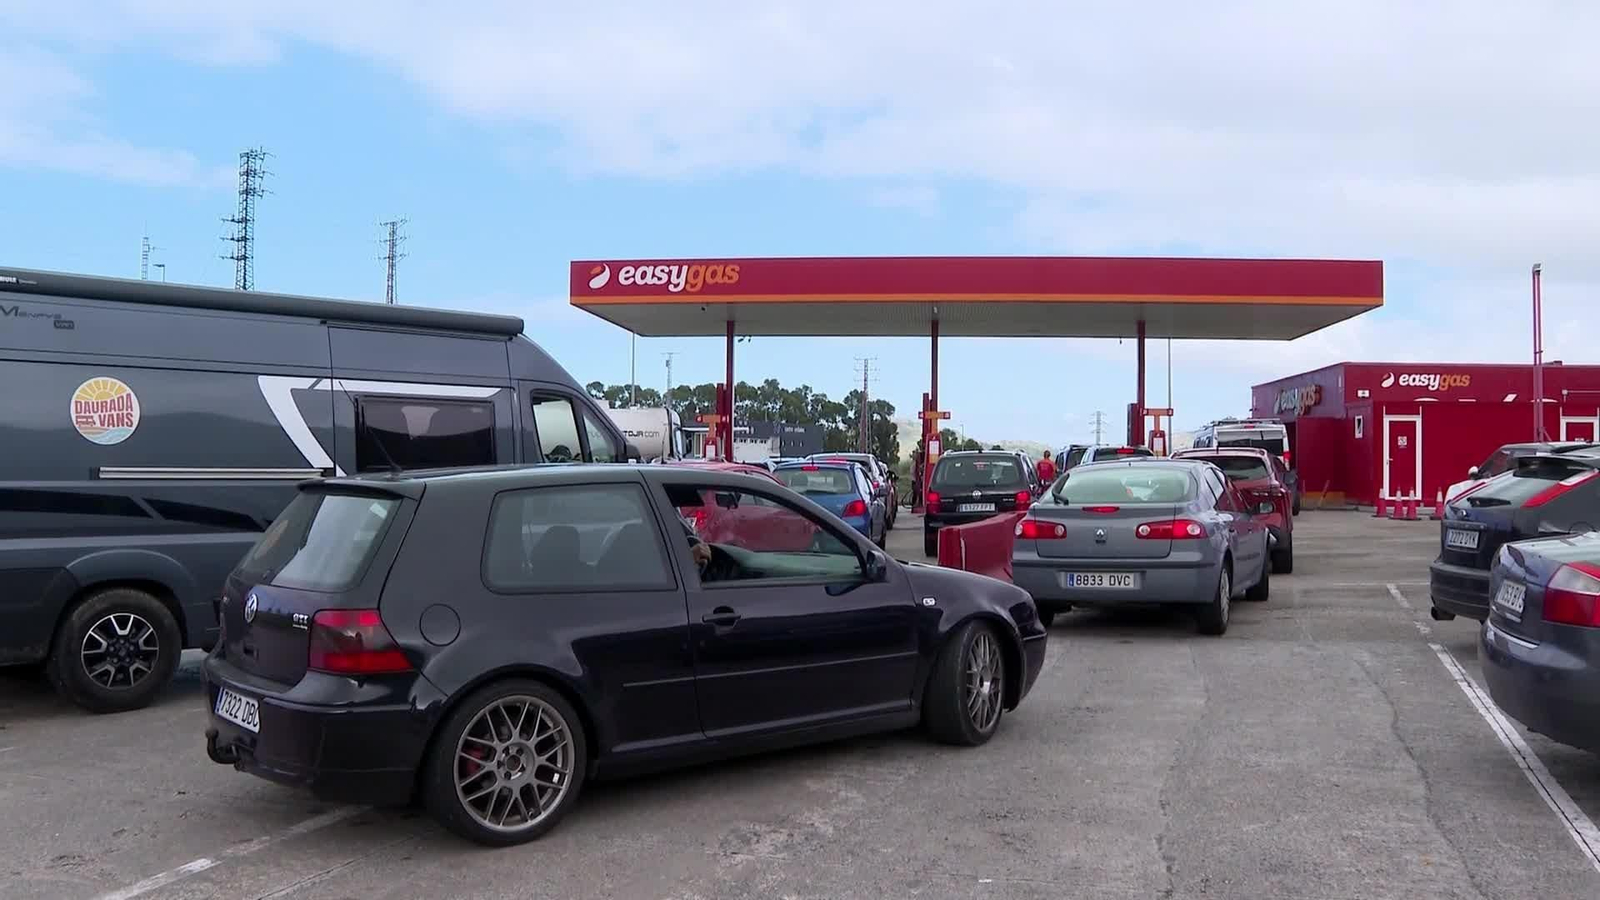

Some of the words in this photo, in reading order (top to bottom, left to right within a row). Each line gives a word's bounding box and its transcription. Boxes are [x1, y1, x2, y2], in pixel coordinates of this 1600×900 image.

[618, 264, 740, 292] easygas
[1399, 373, 1471, 391] easygas
[74, 393, 134, 415] DAURADA
[1280, 383, 1322, 417] easygas
[98, 412, 134, 428] VANS
[1075, 574, 1104, 586] 8833
[1108, 574, 1131, 586] DVC
[221, 690, 243, 719] 7322
[241, 700, 259, 728] DBC
